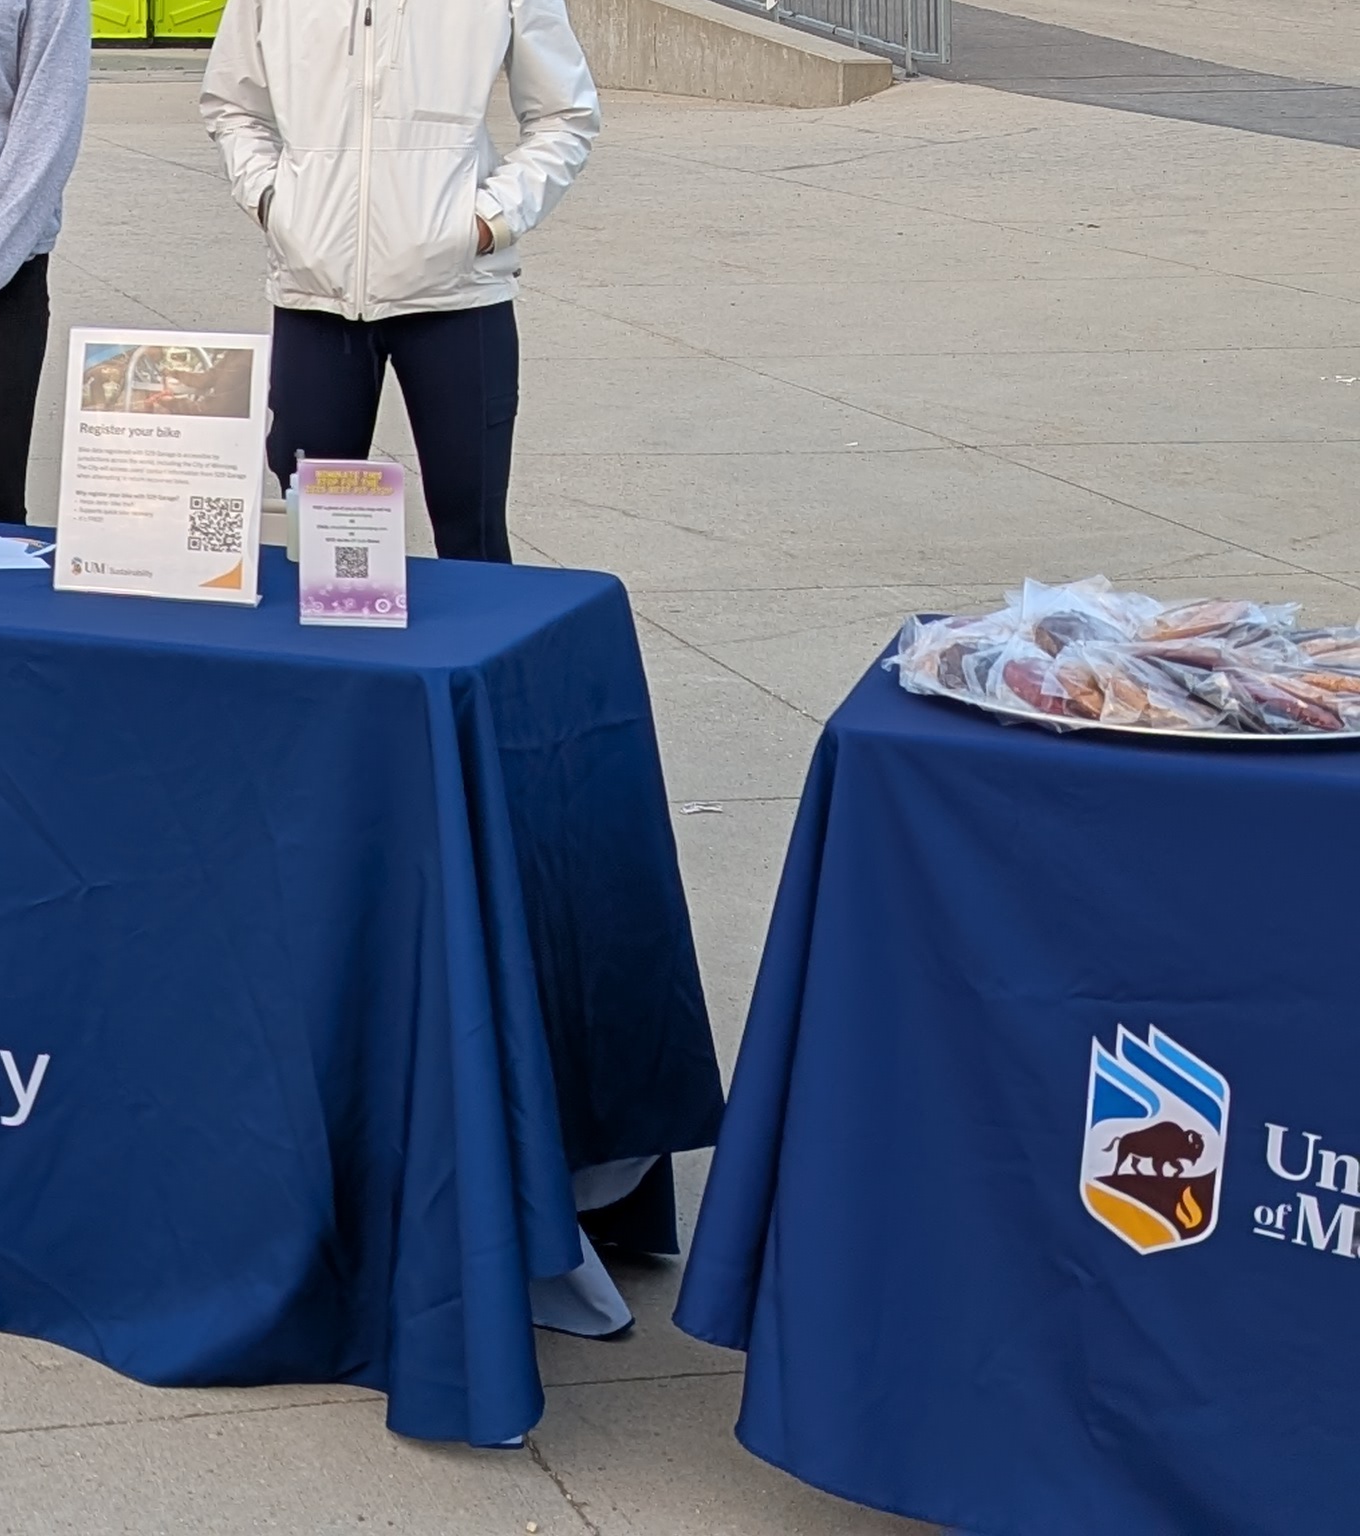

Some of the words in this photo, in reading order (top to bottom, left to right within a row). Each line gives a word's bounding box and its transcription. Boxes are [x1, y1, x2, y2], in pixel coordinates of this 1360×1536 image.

[80, 423, 125, 437] Register
[128, 427, 153, 438] your
[156, 427, 181, 438] bike
[85, 561, 105, 574] UM
[1254, 1203, 1292, 1232] of
[1291, 1191, 1360, 1259] M
